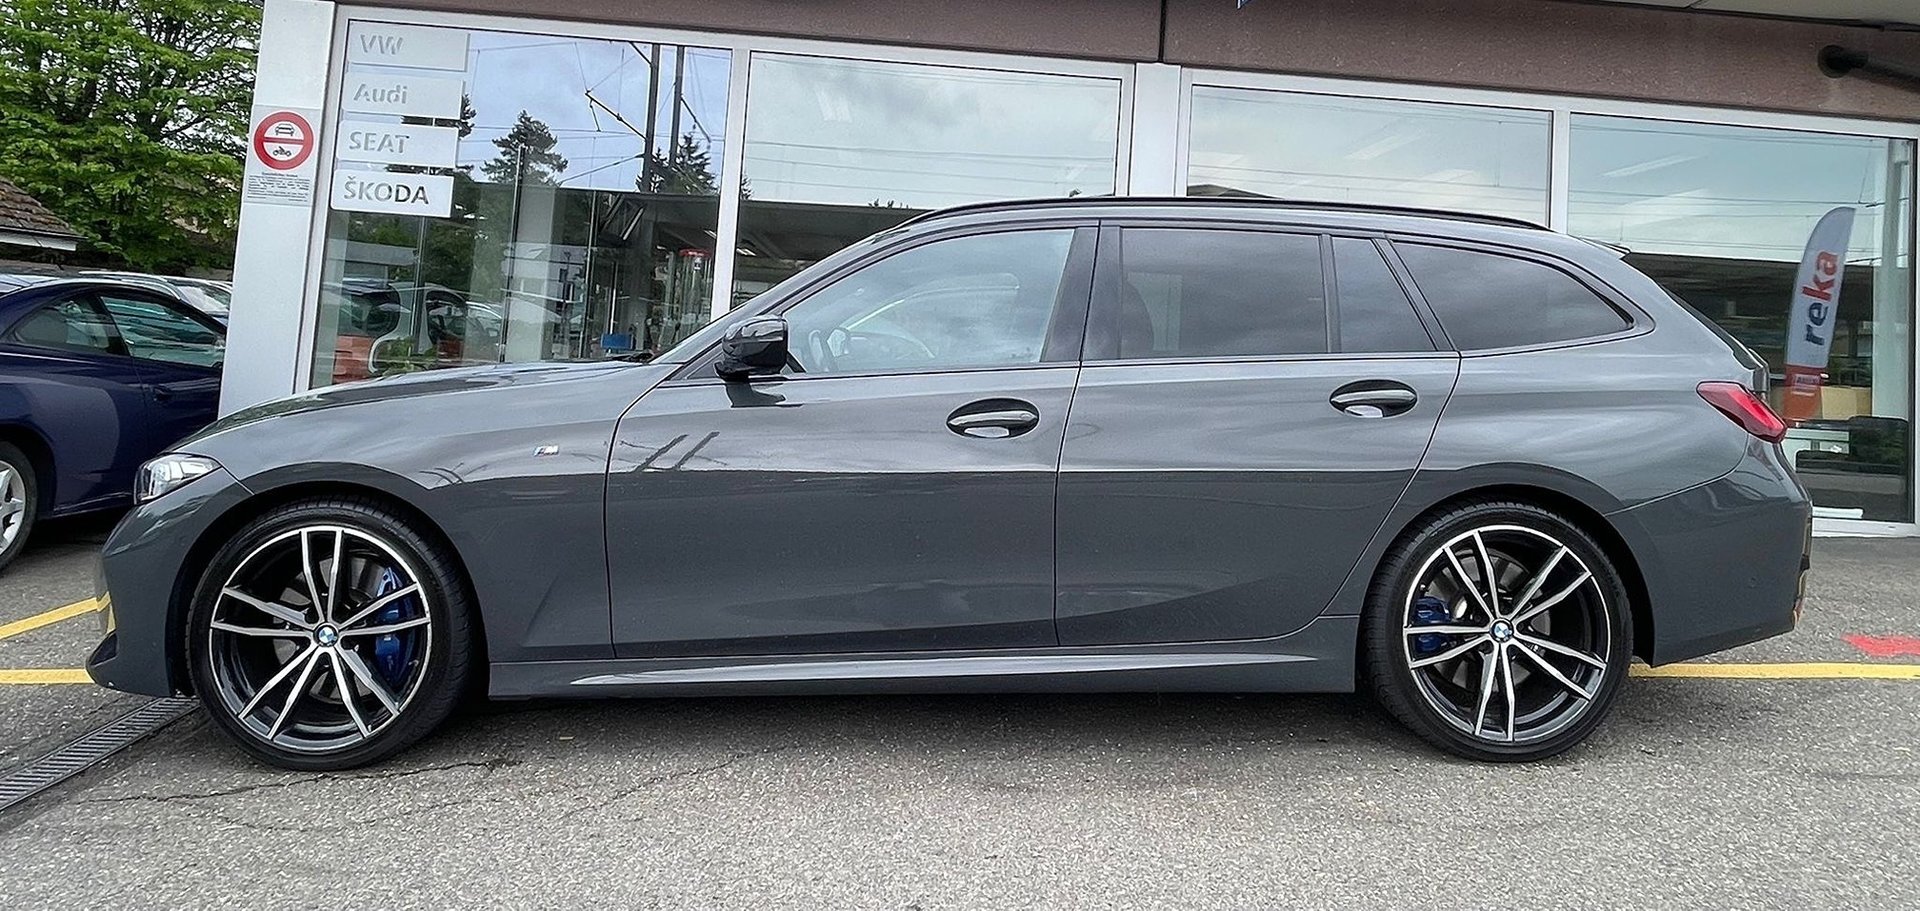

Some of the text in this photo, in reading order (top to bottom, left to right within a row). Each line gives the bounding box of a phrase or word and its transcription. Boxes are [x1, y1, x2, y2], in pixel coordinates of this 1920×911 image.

[360, 34, 404, 55] VW
[353, 83, 408, 104] Audi
[349, 131, 410, 154] SEAT
[343, 175, 429, 205] ŠKODA
[1802, 251, 1838, 346] reka
